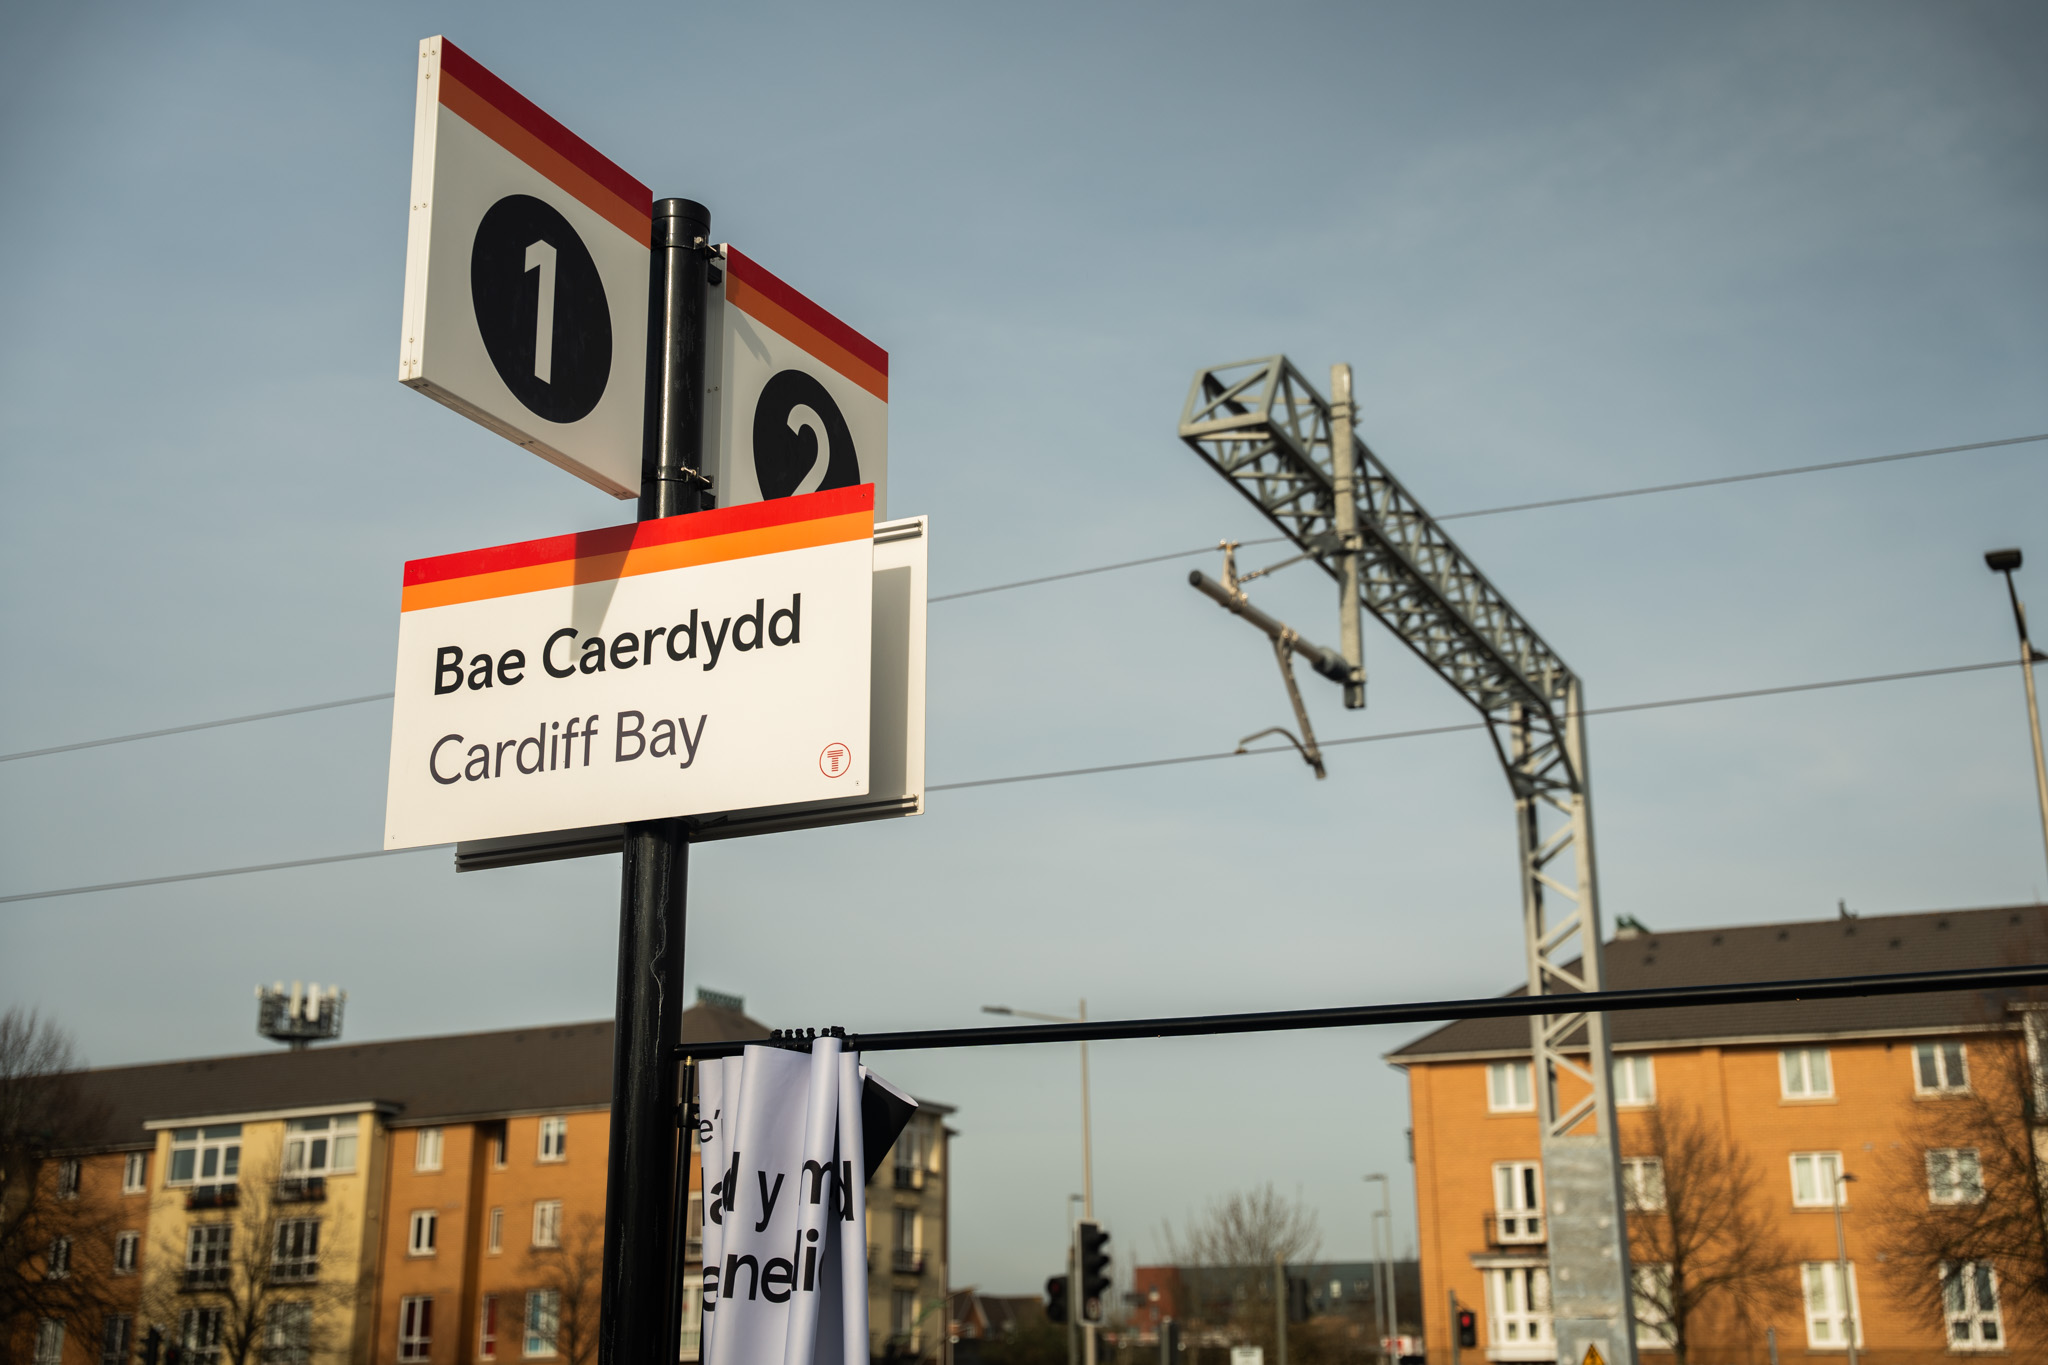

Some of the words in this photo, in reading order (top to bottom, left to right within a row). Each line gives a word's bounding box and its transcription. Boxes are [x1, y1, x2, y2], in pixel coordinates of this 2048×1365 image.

[524, 239, 557, 384] 1
[787, 404, 830, 498] 2
[434, 645, 525, 695] Bae
[543, 593, 801, 679] Caerdydd
[429, 714, 599, 785] Cardiff
[615, 710, 708, 769] Bay
